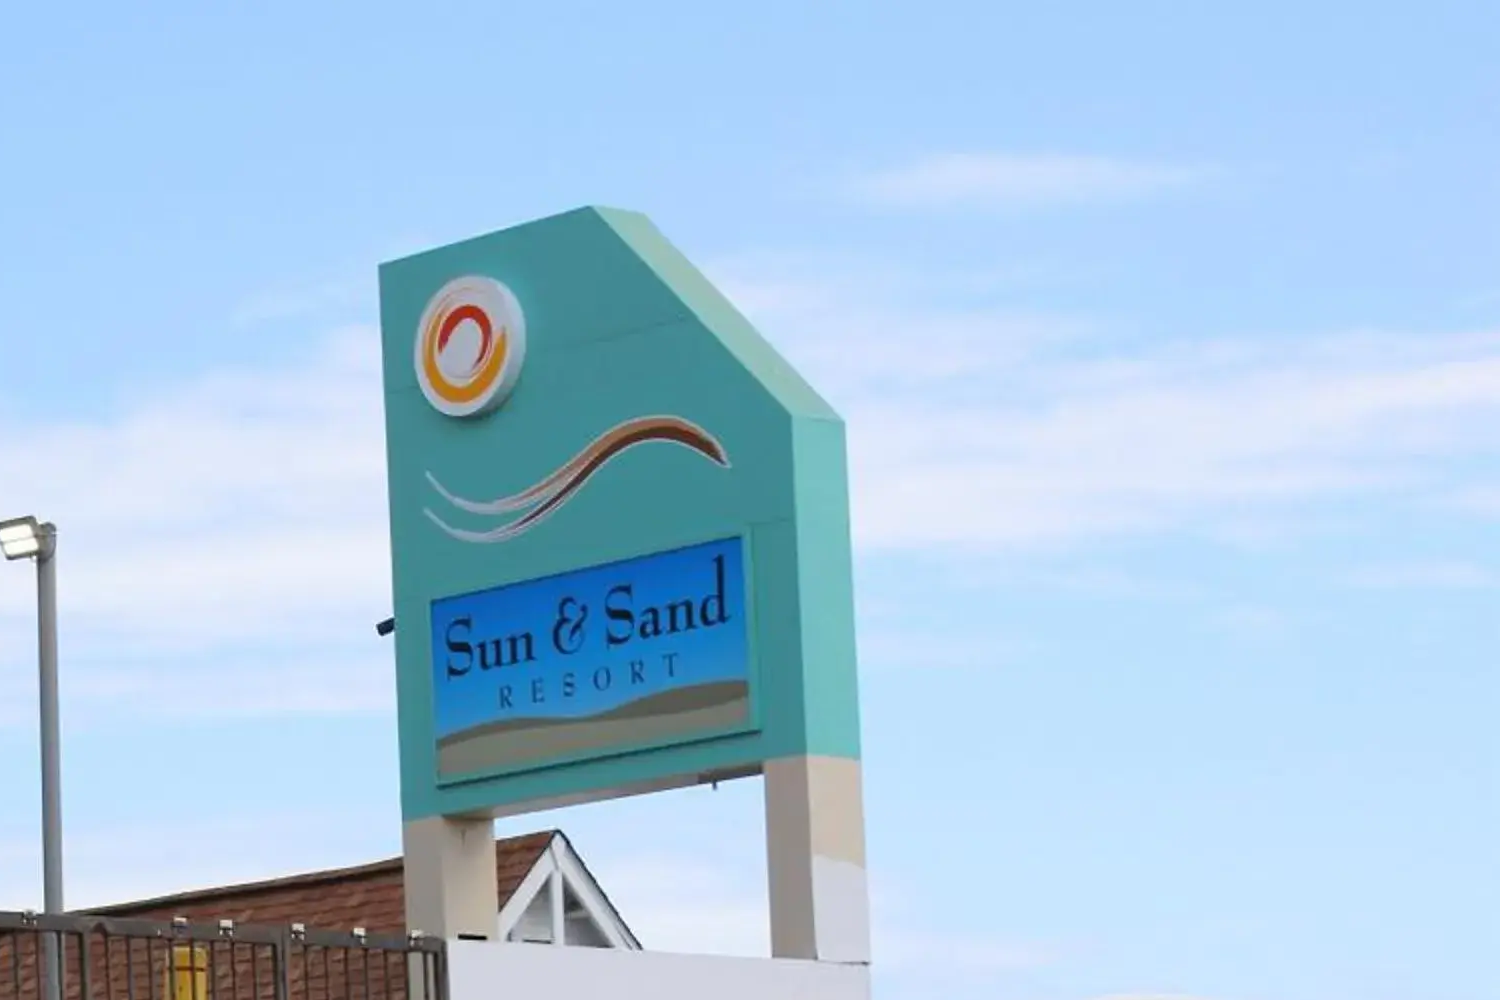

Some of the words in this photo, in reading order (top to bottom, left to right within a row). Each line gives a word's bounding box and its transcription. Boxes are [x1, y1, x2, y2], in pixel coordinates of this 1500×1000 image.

[445, 613, 536, 681] Sun
[553, 596, 588, 654] &
[605, 554, 731, 650] Sand
[498, 652, 680, 710] RESORT
